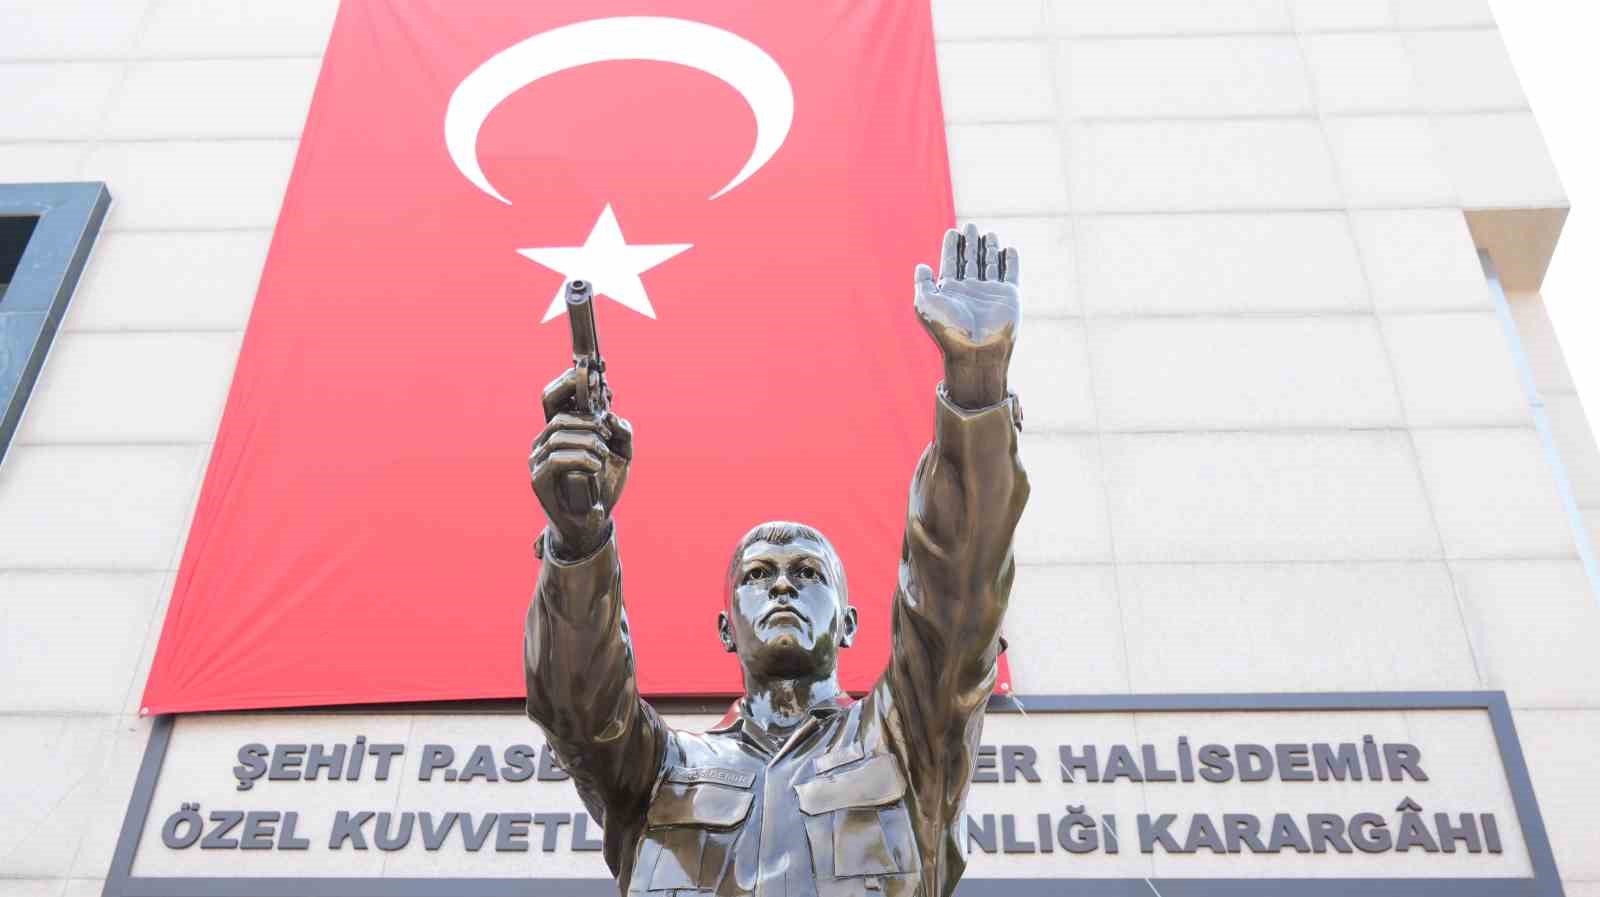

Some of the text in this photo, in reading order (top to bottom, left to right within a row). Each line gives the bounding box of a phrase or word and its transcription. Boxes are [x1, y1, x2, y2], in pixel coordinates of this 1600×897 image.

[234, 735, 405, 792] ŞEHİT
[1058, 734, 1431, 785] HALİSDEMİR
[161, 794, 1504, 857] ÖZEL KUVVETL NLIĞI KARARGÂHI
